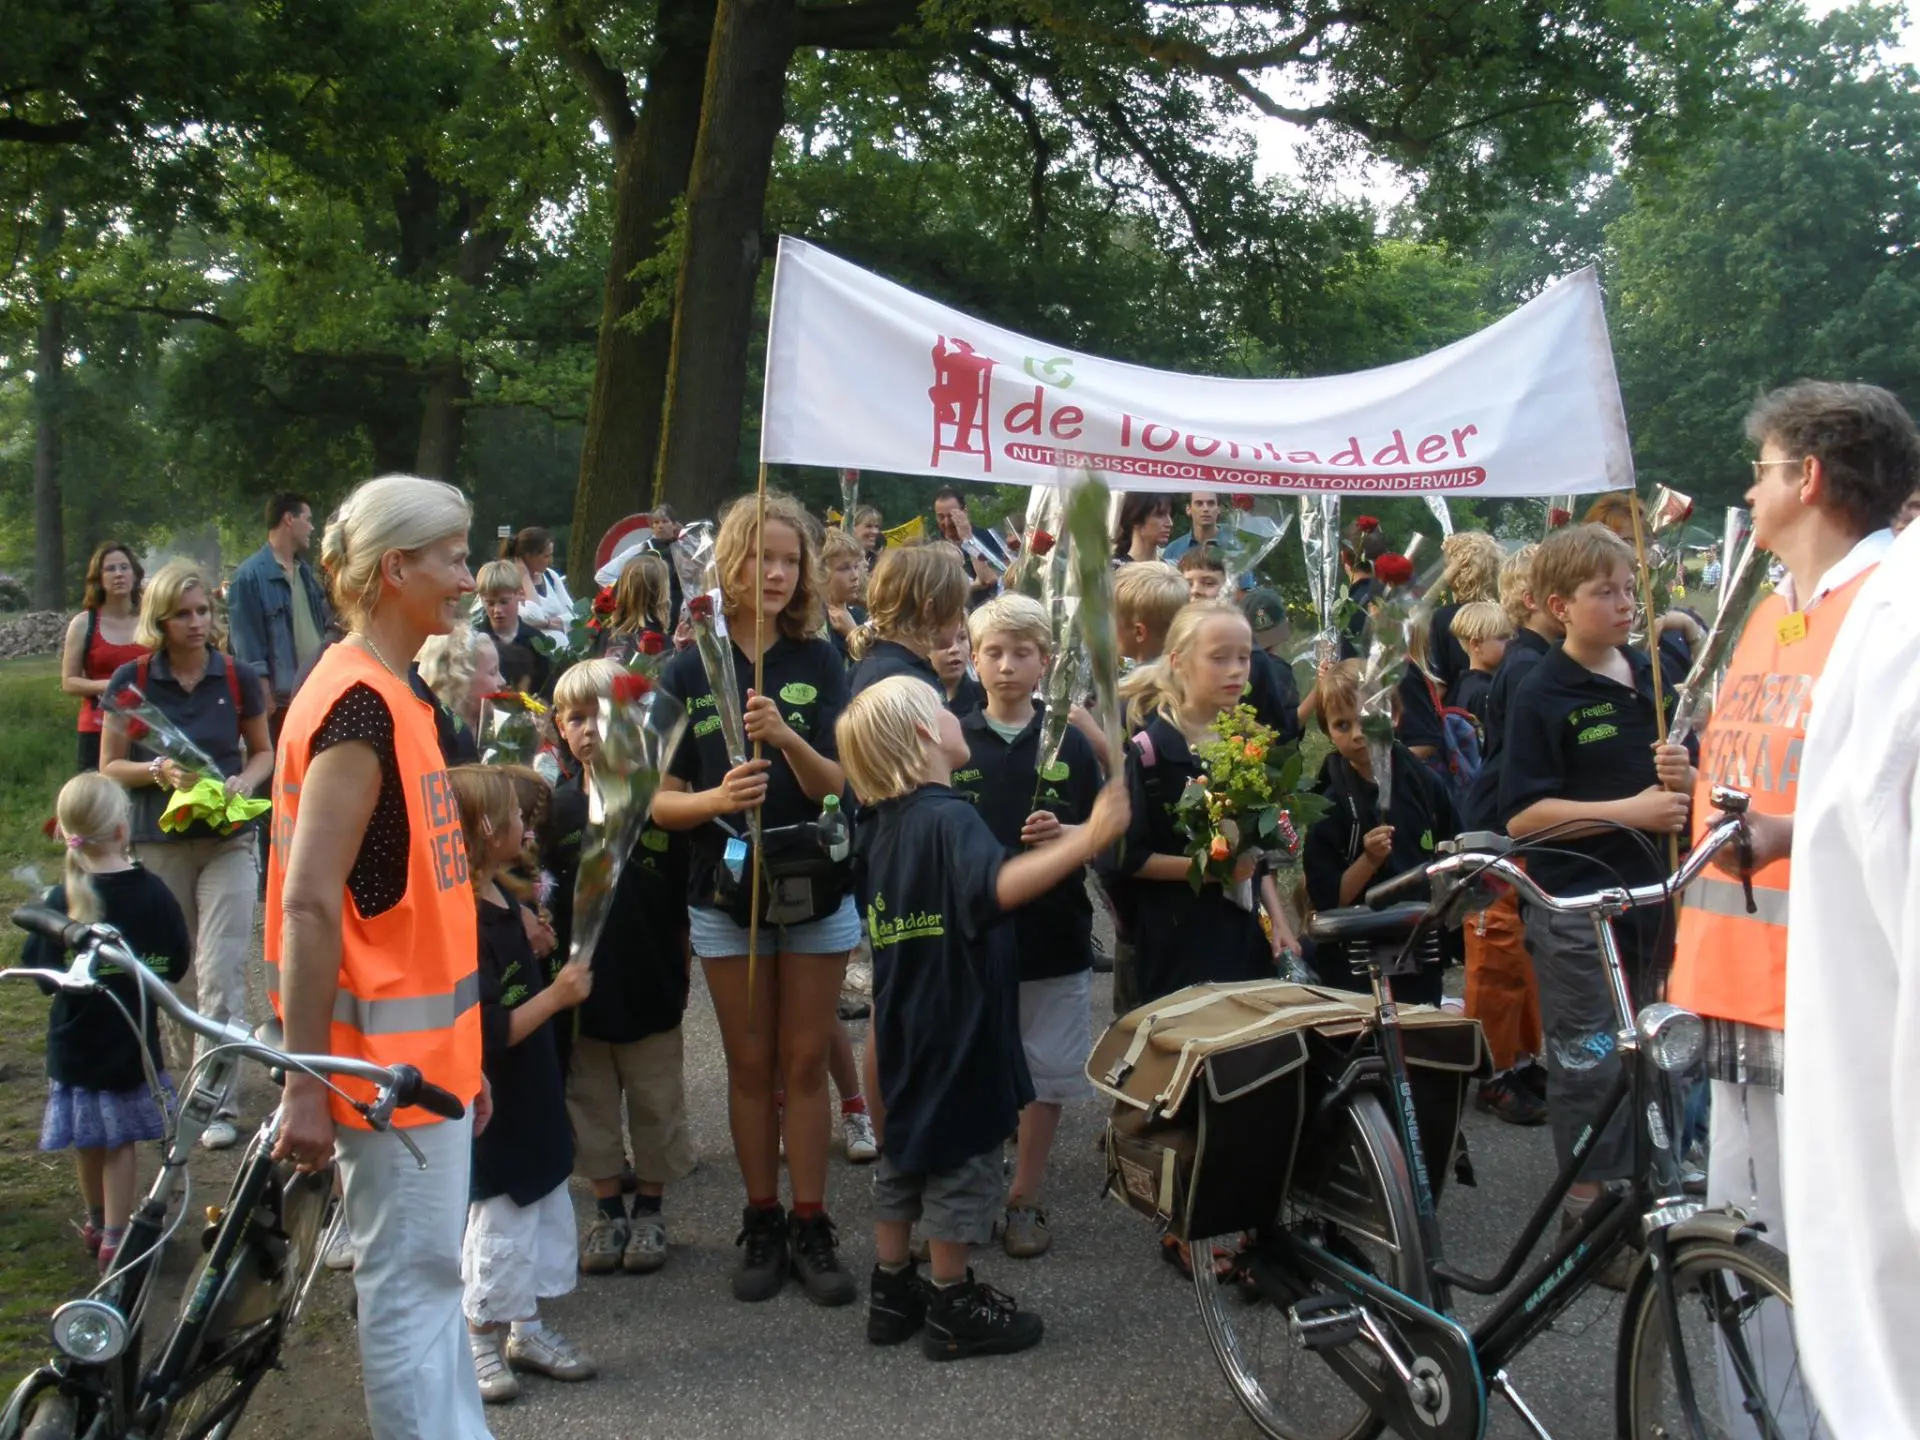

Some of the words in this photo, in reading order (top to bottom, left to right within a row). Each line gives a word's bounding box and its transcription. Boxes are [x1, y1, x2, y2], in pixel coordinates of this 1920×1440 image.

[1003, 384, 1084, 440] de
[1012, 445, 1206, 480] NUTSBASISSCHOOL
[1212, 468, 1272, 486] VOOR
[1279, 469, 1478, 490] DALTONONDERWIJS
